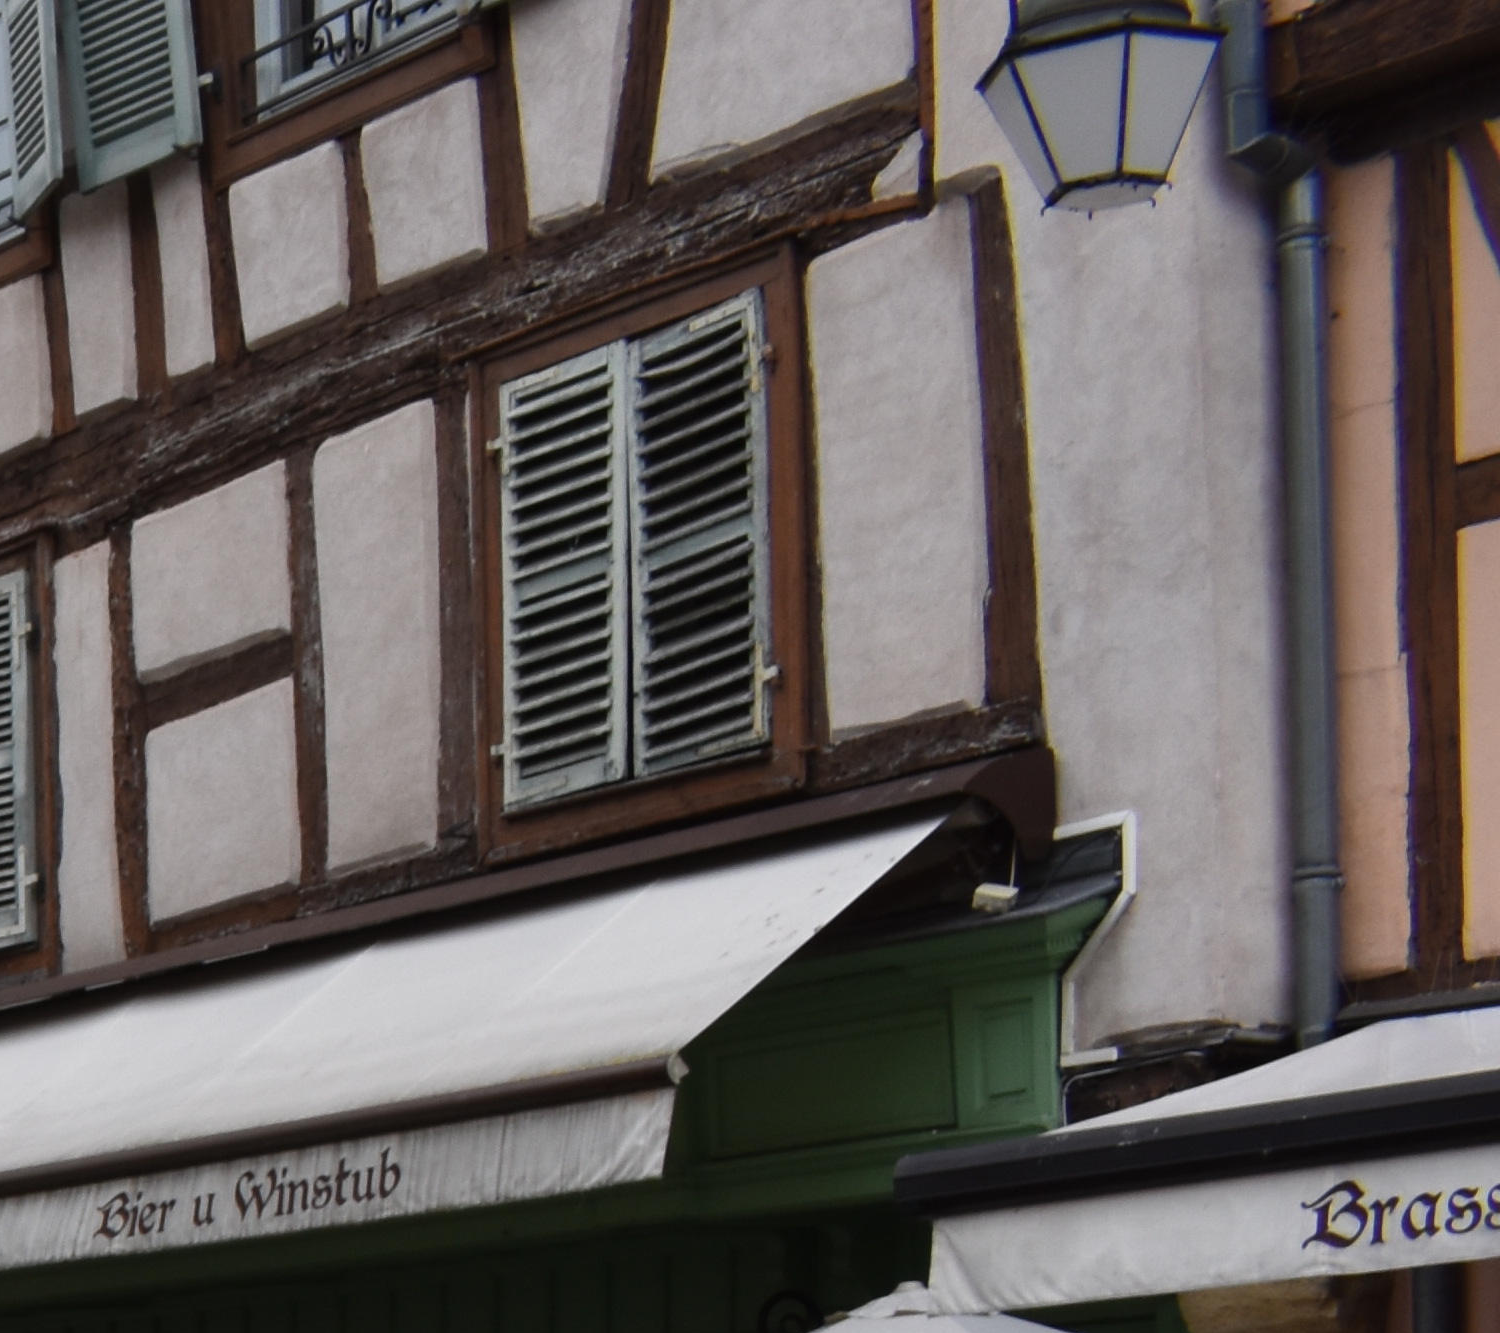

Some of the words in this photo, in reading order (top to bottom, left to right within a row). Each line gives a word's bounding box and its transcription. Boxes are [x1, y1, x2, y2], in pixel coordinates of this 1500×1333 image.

[93, 1189, 177, 1245] Bier
[192, 1193, 215, 1228] u
[232, 1147, 402, 1225] Winstub
